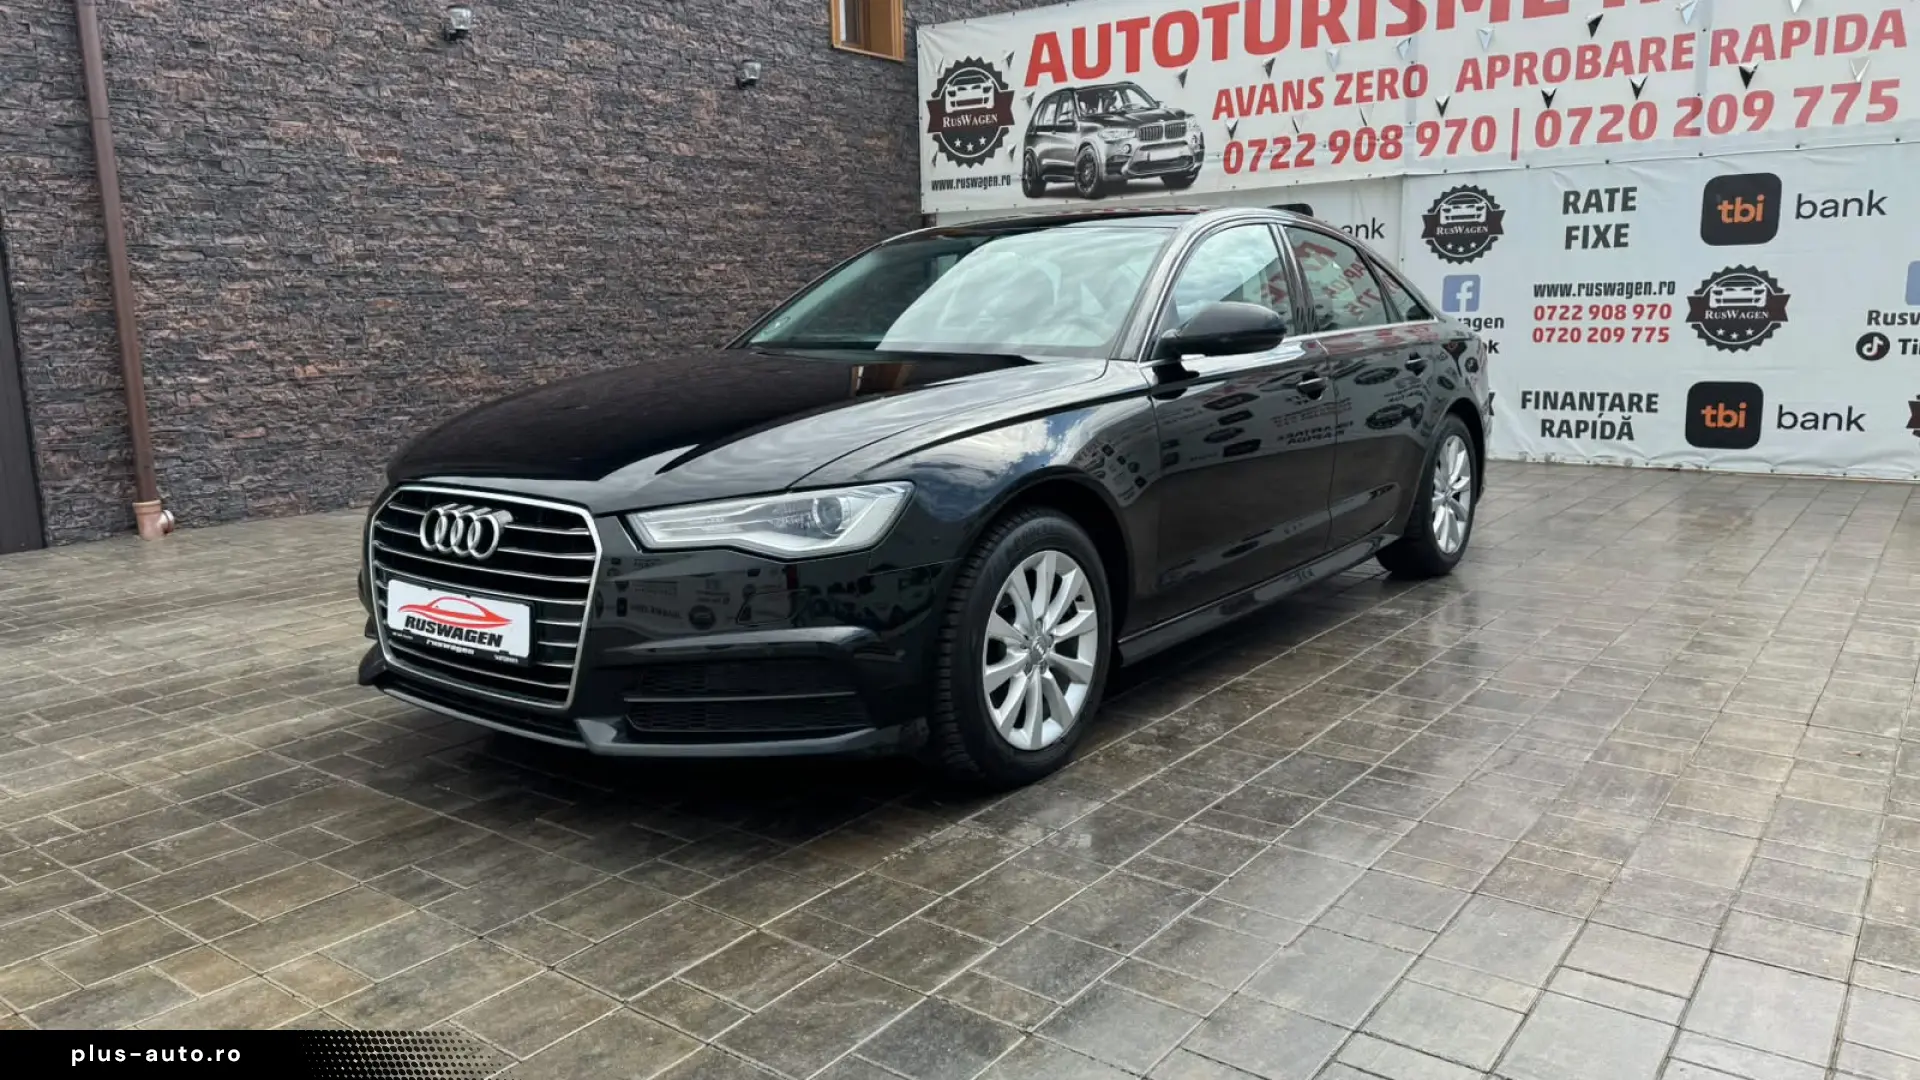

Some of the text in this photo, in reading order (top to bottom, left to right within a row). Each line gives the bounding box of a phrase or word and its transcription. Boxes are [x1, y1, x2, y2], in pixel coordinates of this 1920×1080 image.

[1212, 9, 1907, 121] AVANS ZERO APROBARE RAPIDA
[1223, 133, 1317, 175] 0722
[1328, 124, 1404, 166] 908
[1416, 115, 1498, 157] 970
[1535, 101, 1658, 148] 0720
[1673, 91, 1774, 138] 209
[1794, 79, 1901, 129] 775
[931, 174, 1011, 191] www.ruswagen.ro
[1562, 186, 1638, 215] RATE
[1717, 189, 1889, 224] tbi bank
[1564, 222, 1630, 250] FIXE
[1533, 280, 1676, 300] www.ruswagen.ro
[1534, 303, 1673, 321] 0722 908 970
[1532, 326, 1670, 343] 0720 209 775
[1540, 415, 1635, 441] RAPIDĂ
[1702, 403, 1866, 432] tbi bank
[405, 615, 503, 647] RUSWAGEN
